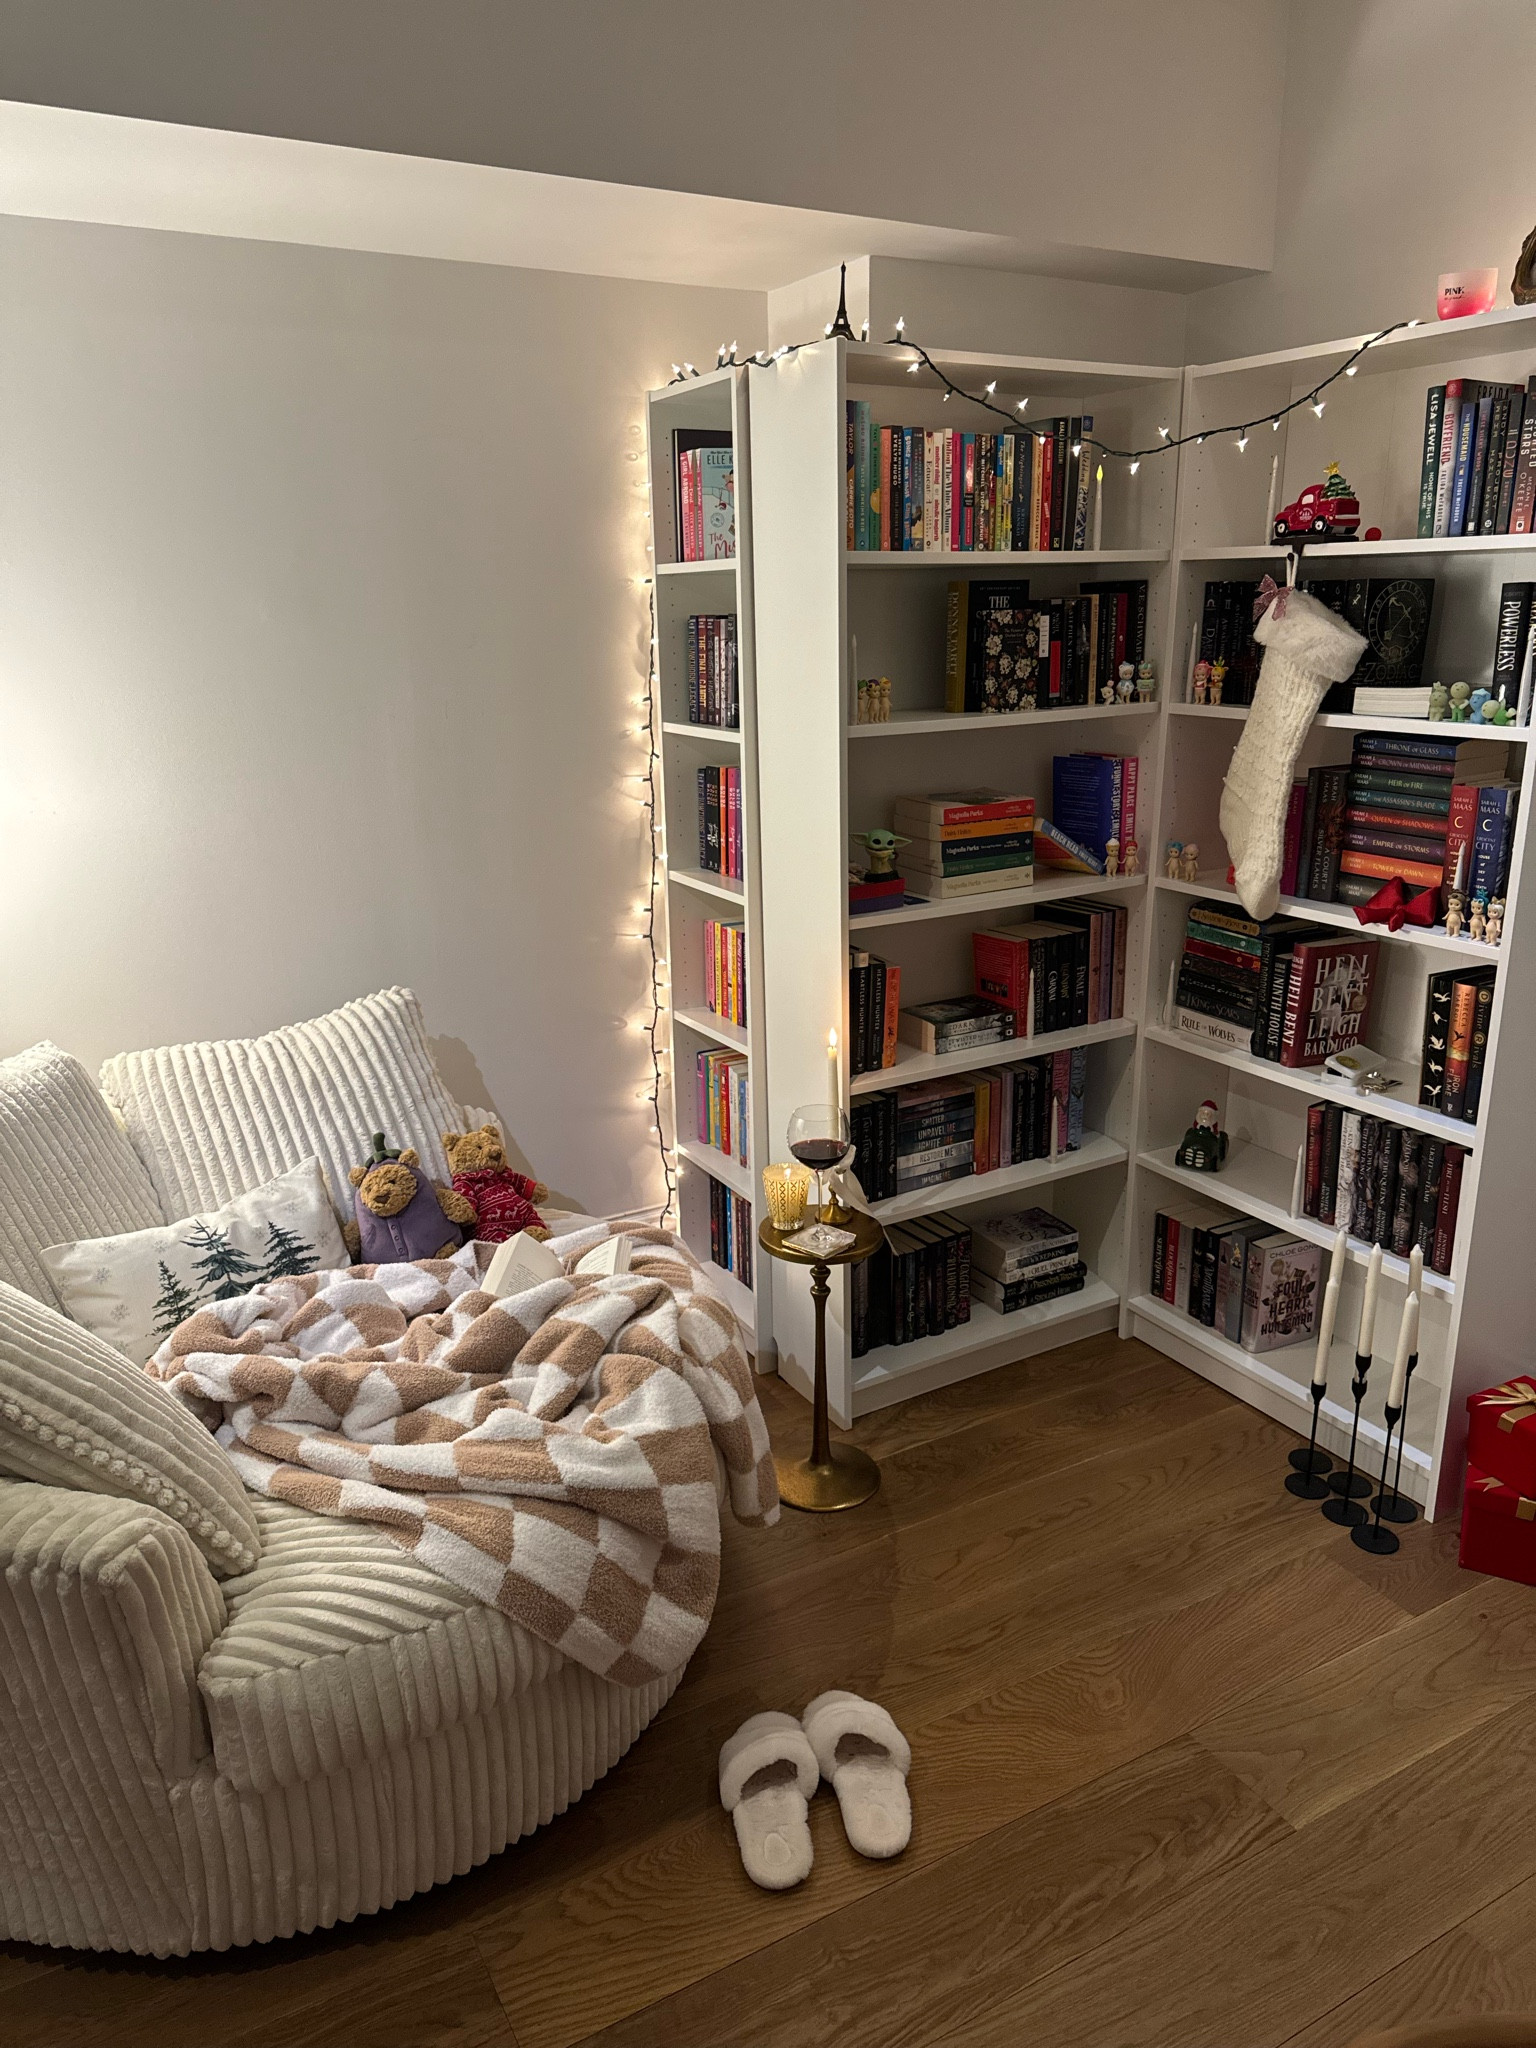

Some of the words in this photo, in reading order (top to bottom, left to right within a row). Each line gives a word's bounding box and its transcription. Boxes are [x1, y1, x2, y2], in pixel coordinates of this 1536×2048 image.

[1444, 286, 1465, 296] PINK
[1429, 393, 1440, 421] LISA
[1480, 410, 1488, 429] THESE
[1493, 405, 1501, 438] WEIR
[1500, 405, 1509, 437] ANDY
[1426, 423, 1437, 466] JEWELL
[1441, 413, 1455, 463] BOYFRIEND
[1459, 423, 1471, 462] HOUSEMAID
[1477, 430, 1486, 449] SILENT
[1520, 419, 1534, 455] STARS
[707, 454, 725, 465] ELLE
[1080, 450, 1091, 483] Wedding
[1475, 451, 1484, 472] WOODS
[1487, 449, 1496, 479] HAIL
[1018, 454, 1026, 490] Nightingale
[1427, 472, 1435, 492] NONE
[1439, 470, 1447, 491] FREIDA
[1491, 452, 1503, 510] PROJECT
[1456, 479, 1464, 496] FREIDA
[1515, 472, 1527, 512] O'KEEFE
[1525, 476, 1533, 502] MEGAN
[1436, 493, 1445, 523] McFADDEN
[1454, 497, 1462, 522] McFADDEN
[1484, 486, 1492, 515] MARY
[951, 591, 960, 634] DONNA
[989, 595, 1010, 609] THE
[1135, 607, 1145, 653] SCHWAB
[1496, 600, 1522, 671] POWERLESS
[688, 645, 696, 684] HAWTHORNE
[950, 638, 959, 678] TARTT
[1363, 661, 1420, 683] ZODIAC
[689, 685, 697, 712] LEGACY
[699, 679, 707, 708] GAMBIT
[1385, 742, 1410, 753] THRONE
[1419, 745, 1439, 755] GLASS
[1127, 762, 1136, 785] HAPPY
[1377, 758, 1402, 768] CROWN
[1409, 761, 1442, 772] MIDNIGHT
[1113, 766, 1121, 788] FUNNY
[1331, 776, 1339, 801] SARAH
[1387, 778, 1403, 787] HEIR
[1410, 781, 1424, 790] FIRE
[1112, 790, 1120, 811] STORY
[1126, 786, 1135, 807] PLACE
[1321, 782, 1329, 803] MAAS
[1383, 797, 1416, 808] ASSASSIN'S
[1416, 800, 1436, 809] BLADE
[1453, 796, 1469, 804] SARAH
[1480, 799, 1496, 807] SARAH
[948, 811, 969, 820] Magnolia
[969, 809, 984, 817] Parks
[1452, 802, 1473, 811] MAAS
[1480, 806, 1500, 815] MAAS
[1111, 819, 1120, 838] EMILY
[1125, 813, 1134, 834] EMILY
[1371, 816, 1393, 826] QUEEN
[1402, 820, 1435, 830] SHADOWS
[1050, 829, 1067, 844] BEACH
[1315, 829, 1324, 856] SILVER
[1372, 839, 1394, 849] EMPIRE
[1403, 844, 1430, 854] STORMS
[1475, 842, 1496, 851] CITY
[946, 847, 967, 855] Magnolia
[1312, 858, 1322, 889] FLAMES
[1321, 856, 1329, 883] COURT
[1372, 863, 1394, 873] TOWER
[1403, 868, 1424, 878] DAWN
[858, 969, 866, 1005] HEARTLESS
[875, 968, 883, 1003] HEARTLESS
[1075, 965, 1086, 998] FINALE
[1286, 975, 1302, 1008] HELL
[1270, 976, 1285, 1011] NINTH
[1191, 994, 1209, 1010] KING
[1215, 1004, 1240, 1021] SCARS
[1452, 994, 1461, 1023] YARROS
[1460, 992, 1471, 1028] REBECCA
[1476, 989, 1492, 1029] Divine
[952, 1022, 974, 1030] DARK
[1181, 1015, 1200, 1031] RULE
[1208, 1025, 1235, 1043] WOLVES
[1266, 1012, 1281, 1047] HOUSE
[1281, 1011, 1297, 1047] BENT
[1306, 1012, 1362, 1040] LEIGH
[1303, 1035, 1358, 1057] BARDUGO
[1472, 1031, 1486, 1069] Rivals
[1444, 1068, 1455, 1097] FLAME
[1451, 1074, 1461, 1094] IRON
[918, 1125, 946, 1140] UNRAVEL
[946, 1123, 957, 1133] ME
[921, 1114, 945, 1127] SHATTER
[944, 1148, 954, 1157] ME
[1383, 1138, 1391, 1155] WAR
[1428, 1147, 1436, 1168] LIGHT
[1445, 1163, 1454, 1179] FIRE
[1398, 1187, 1407, 1212] EMBER
[1441, 1192, 1451, 1215] FLESH
[1269, 1248, 1296, 1259] CHLOE
[1297, 1243, 1319, 1252] GONG
[1435, 1227, 1443, 1266] ARMENTROUT
[959, 1258, 970, 1298] FOXGLOVE
[1031, 1264, 1047, 1275] CRUEL
[1277, 1279, 1303, 1297] FOUL
[1268, 1295, 1308, 1318] HEART
